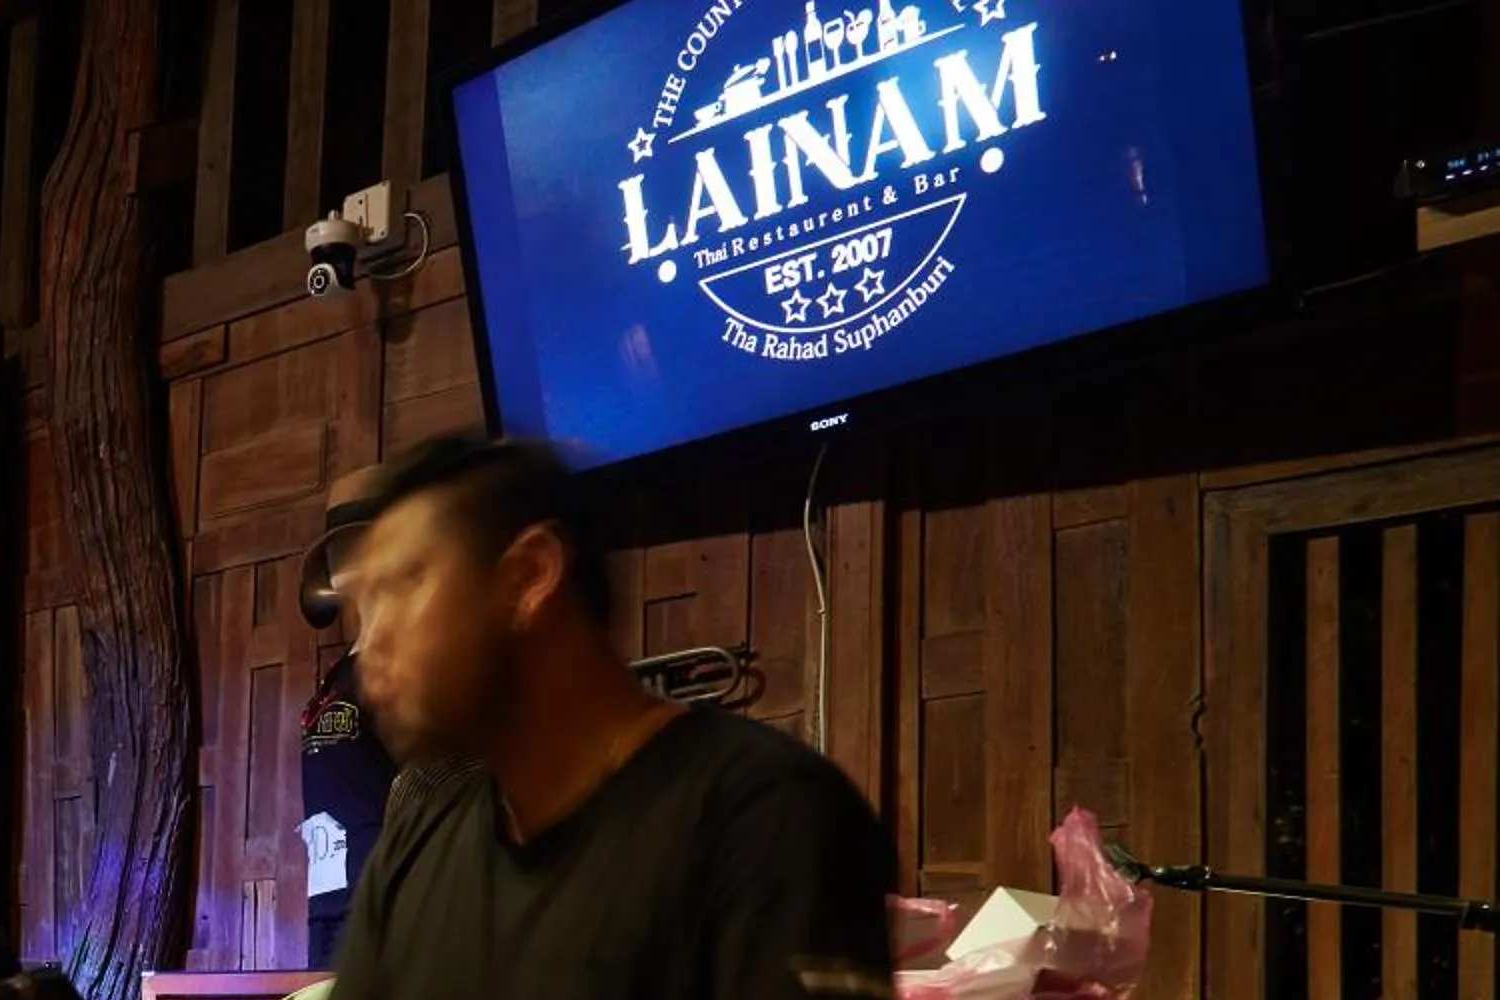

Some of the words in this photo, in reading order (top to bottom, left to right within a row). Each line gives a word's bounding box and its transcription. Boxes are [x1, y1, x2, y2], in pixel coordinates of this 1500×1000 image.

[618, 22, 1048, 264] LAINAM
[653, 73, 686, 128] THE
[693, 243, 729, 269] Thai
[731, 196, 874, 258] Restaurent
[881, 185, 898, 206] &
[913, 167, 961, 196] Bar
[763, 252, 826, 295] EST.
[830, 226, 894, 274] 2007
[721, 317, 758, 353] Tha
[761, 333, 828, 361] Rahad
[832, 255, 956, 354] Suphanburi
[809, 412, 850, 432] SONY
